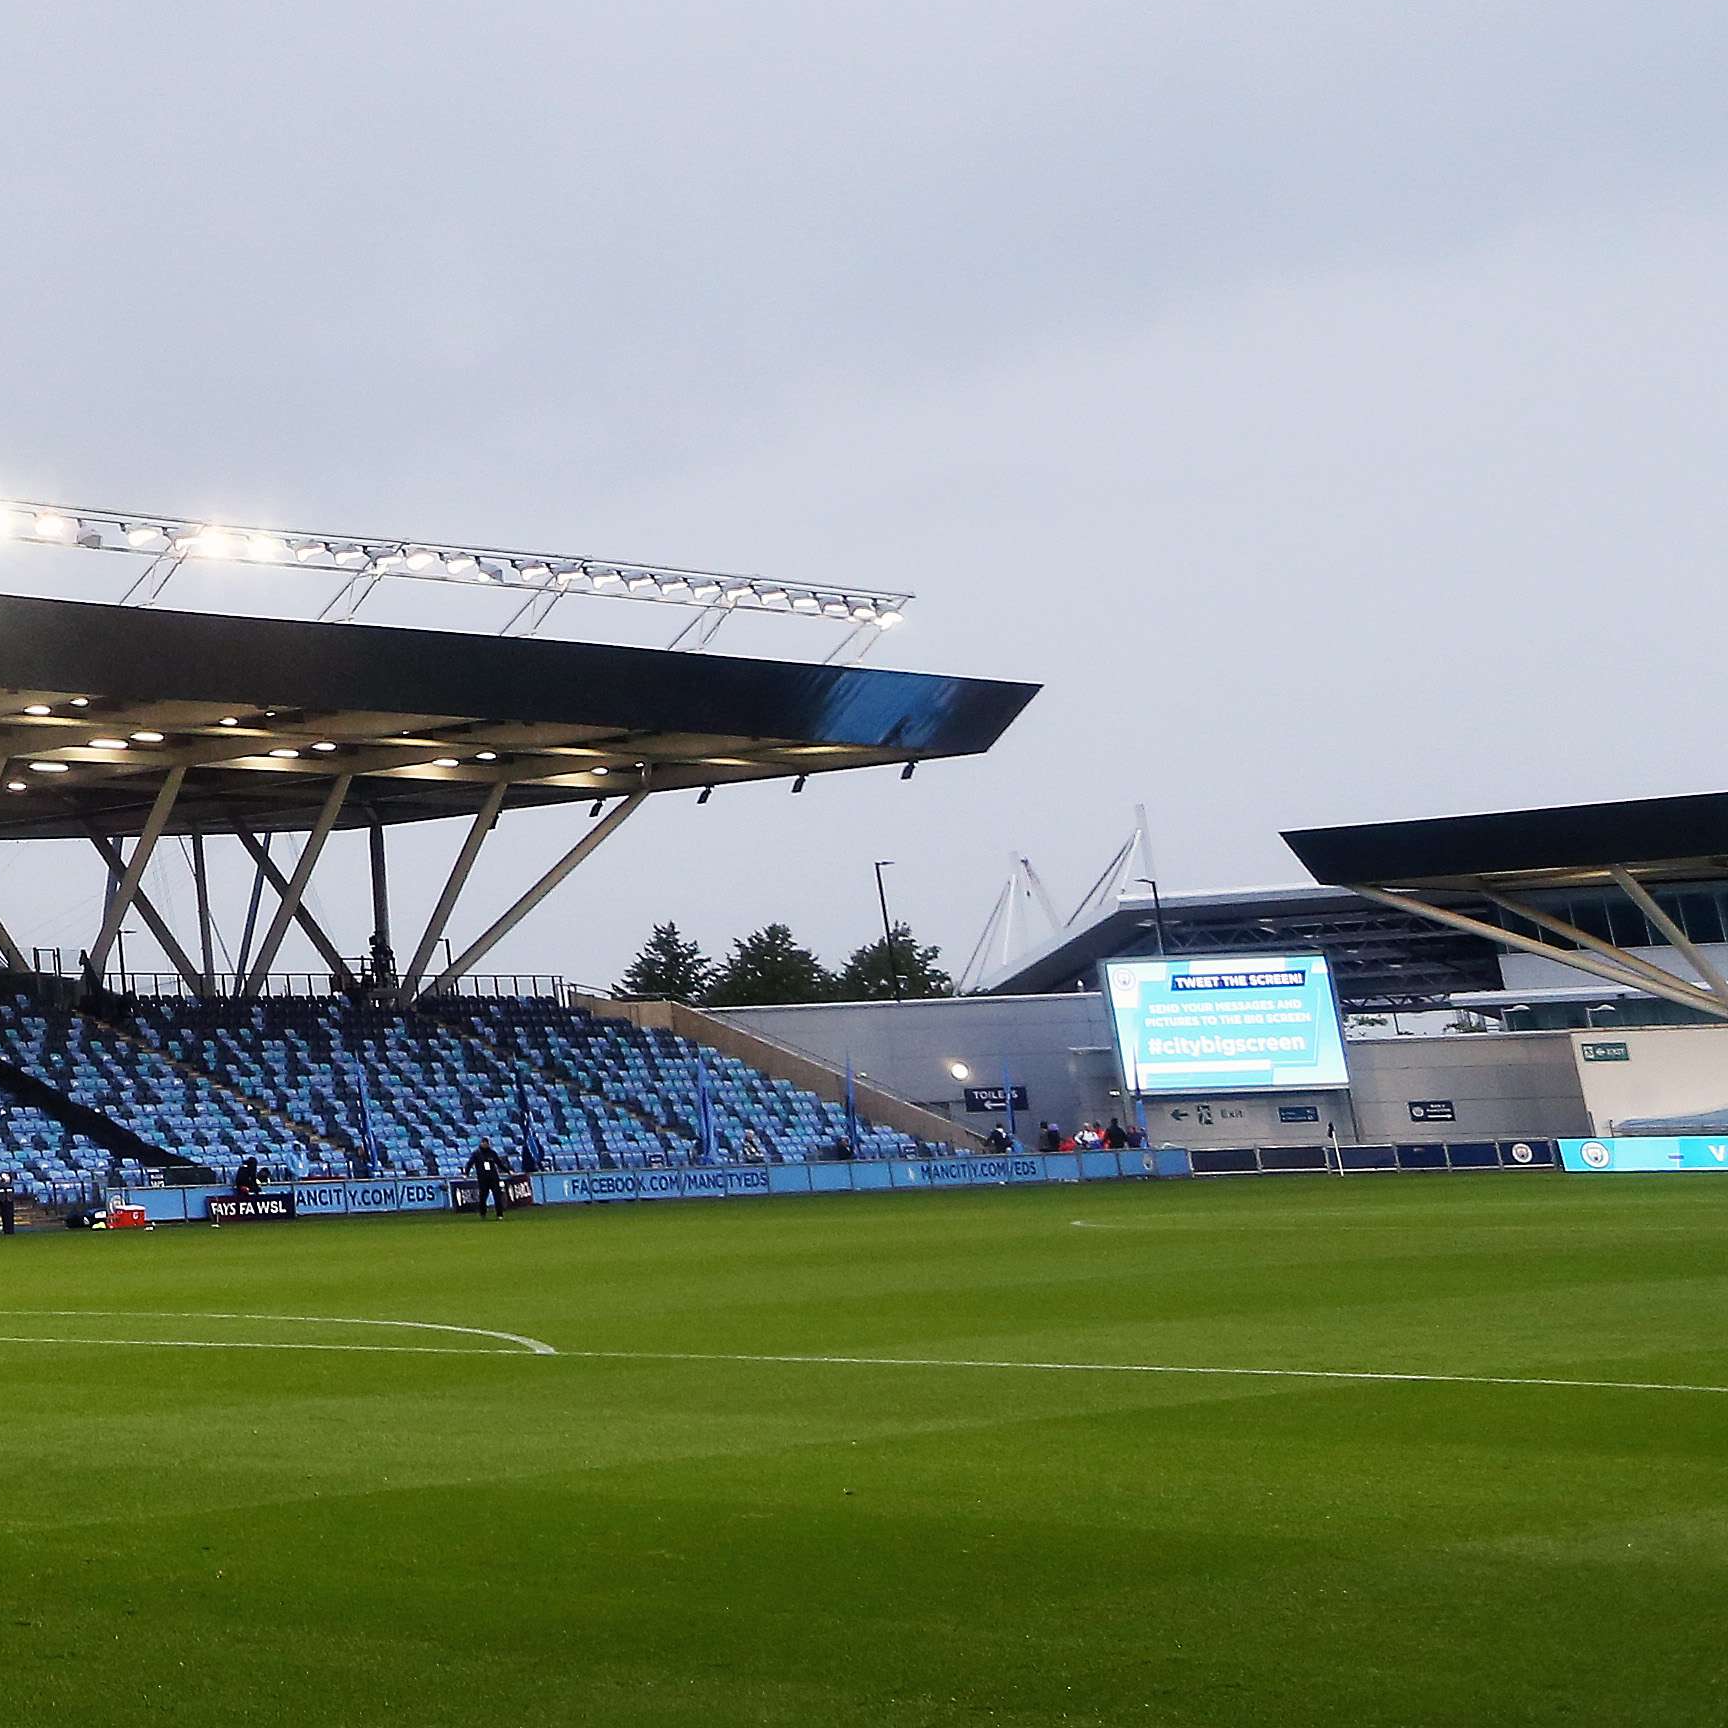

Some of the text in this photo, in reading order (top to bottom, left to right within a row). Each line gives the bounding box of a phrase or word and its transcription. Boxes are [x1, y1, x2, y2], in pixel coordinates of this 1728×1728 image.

[1175, 973, 1304, 989] TWEET THE SCREEN!
[1149, 999, 1303, 1014] SEND YOUR MESSAGES AND
[1145, 1012, 1312, 1028] PICTURES TO THE BIG SCREEN
[1148, 1034, 1307, 1057] #citybigscreen
[972, 1090, 1018, 1100] TOILES
[239, 1202, 256, 1215] FA
[257, 1200, 287, 1214] WSL
